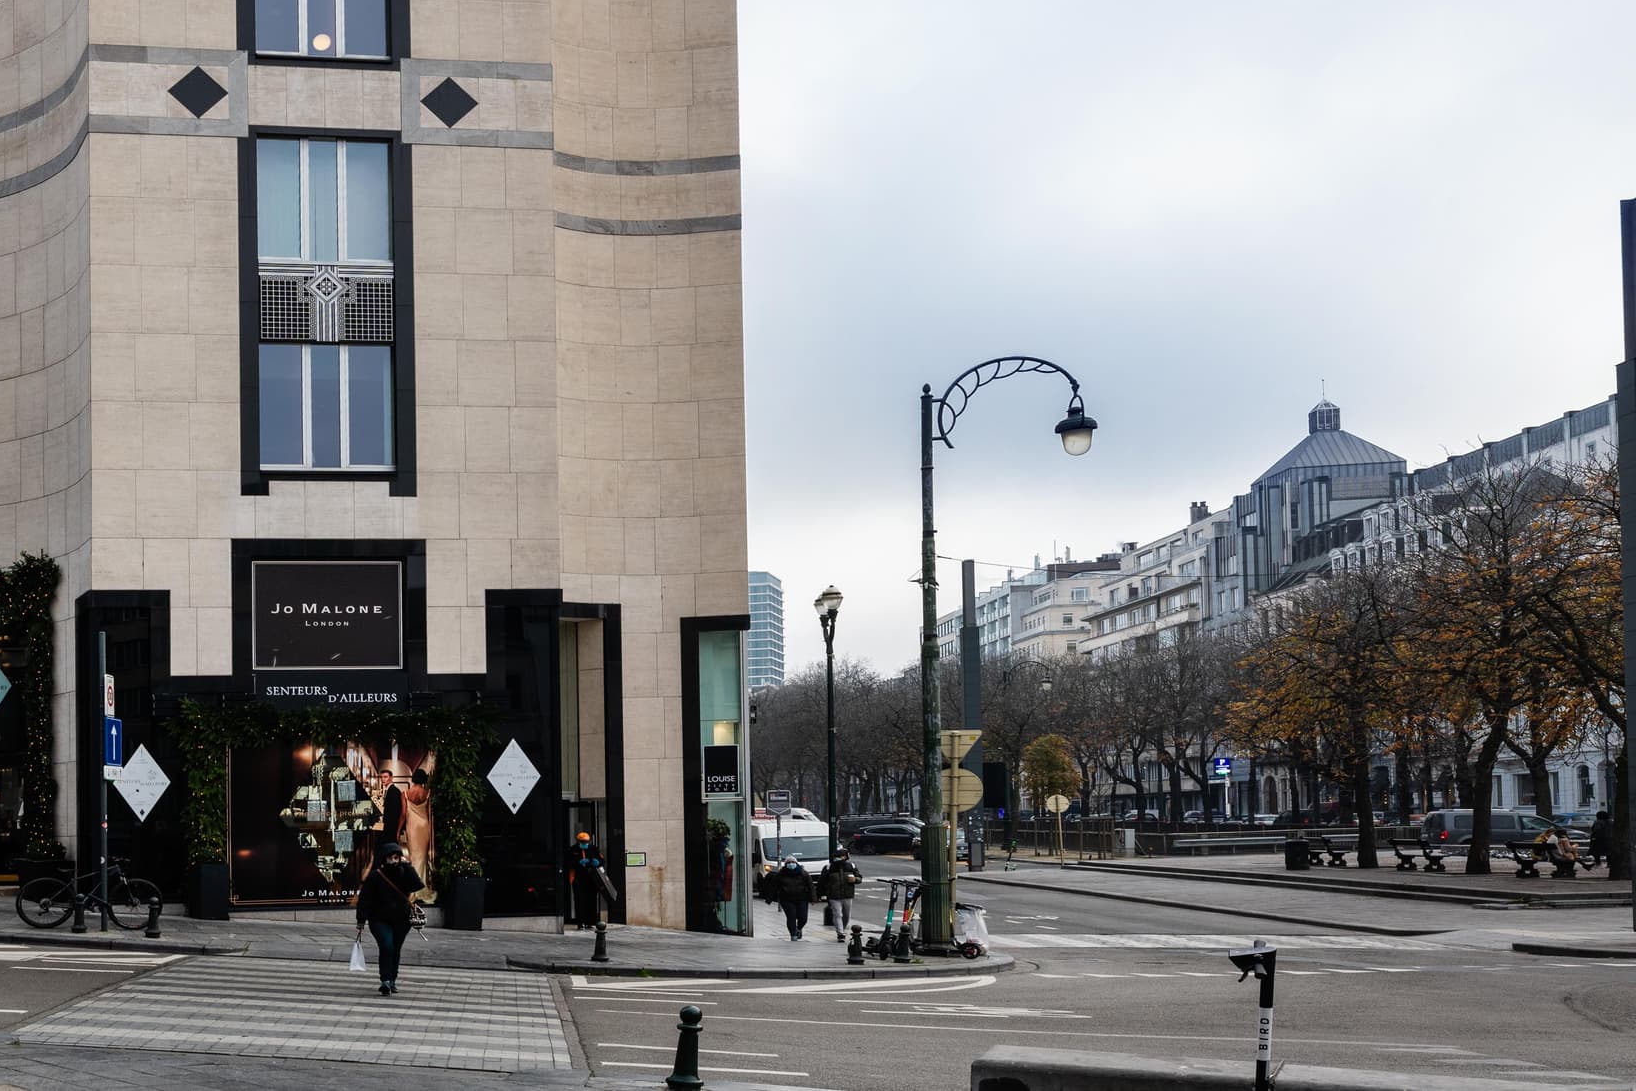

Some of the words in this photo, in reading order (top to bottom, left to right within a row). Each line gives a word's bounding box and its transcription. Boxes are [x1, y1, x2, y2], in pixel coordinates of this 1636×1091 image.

[271, 603, 293, 614] JO
[302, 603, 383, 614] MALONE
[266, 686, 328, 696] SENTEURS
[328, 693, 398, 703] D'AILLEURS
[707, 775, 736, 783] LOUISE
[1258, 1017, 1270, 1051] BIRD
